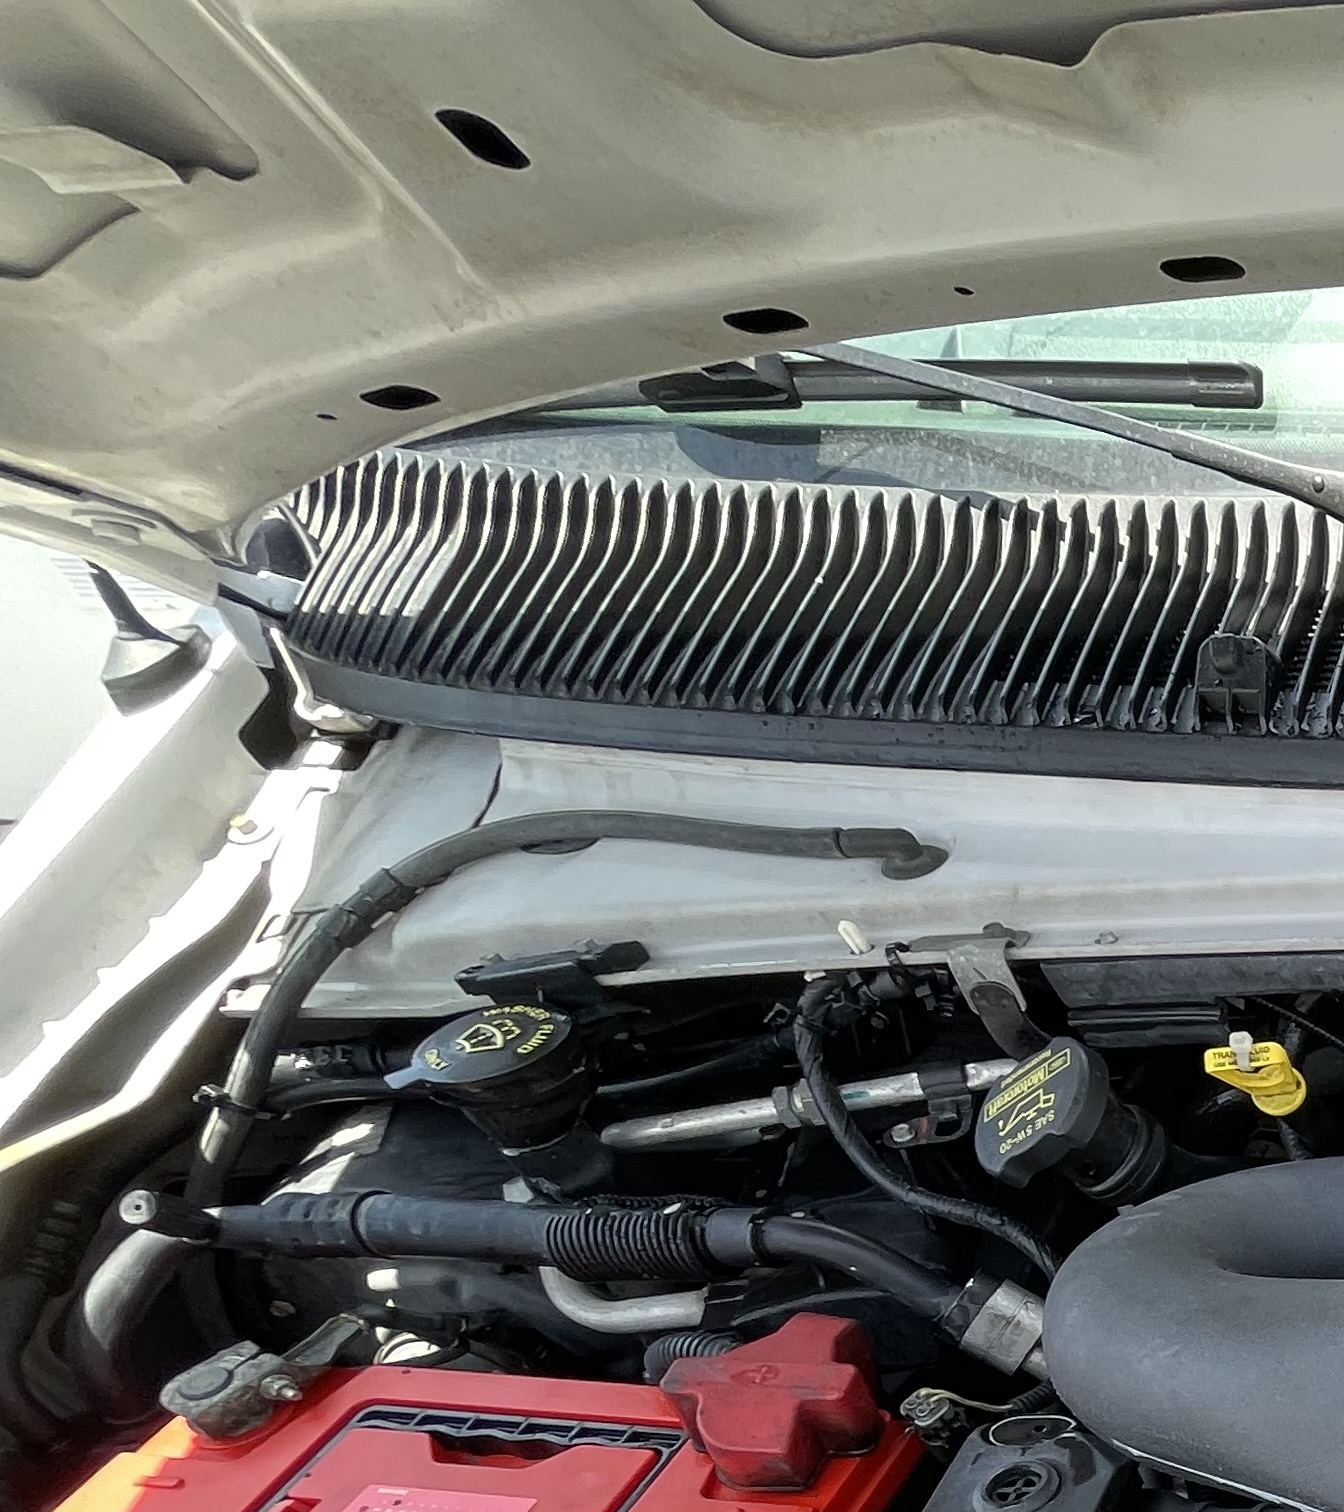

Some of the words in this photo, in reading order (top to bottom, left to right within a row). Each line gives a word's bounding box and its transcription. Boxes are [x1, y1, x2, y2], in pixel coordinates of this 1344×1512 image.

[516, 1023, 555, 1055] FLUID
[988, 1067, 1046, 1116] Motorcraft
[1034, 1109, 1056, 1131] SAE
